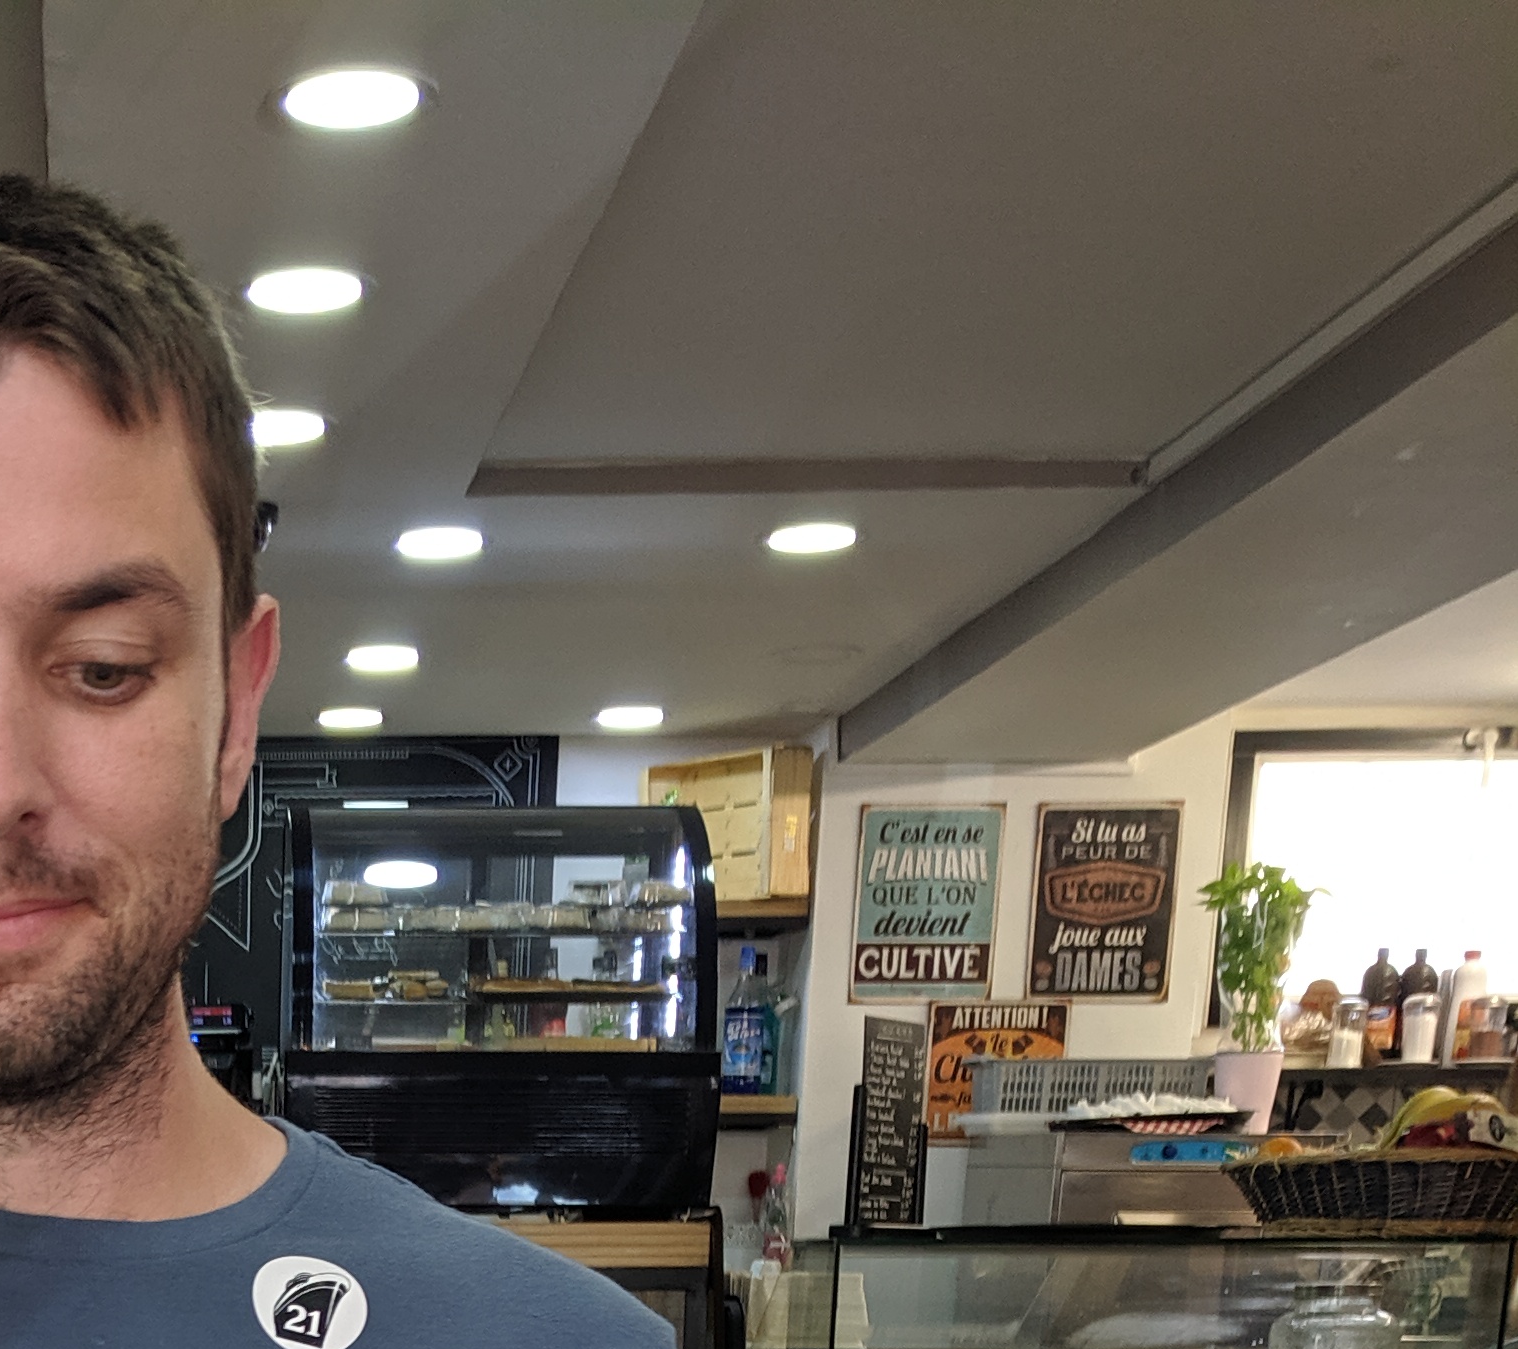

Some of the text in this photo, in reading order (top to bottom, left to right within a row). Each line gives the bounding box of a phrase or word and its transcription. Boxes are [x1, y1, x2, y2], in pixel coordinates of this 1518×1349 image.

[879, 820, 984, 844] C'est en se
[1071, 816, 1146, 844] Si tu as
[866, 847, 988, 886] PLANTANT
[1062, 843, 1152, 860] PEUR DE
[872, 885, 977, 907] QUE L'ON
[873, 910, 971, 937] devient
[1048, 921, 1147, 955] joue aux
[858, 944, 981, 980] CULTIVÉ
[1054, 951, 1142, 992] DAMES
[283, 1304, 321, 1338] 21
